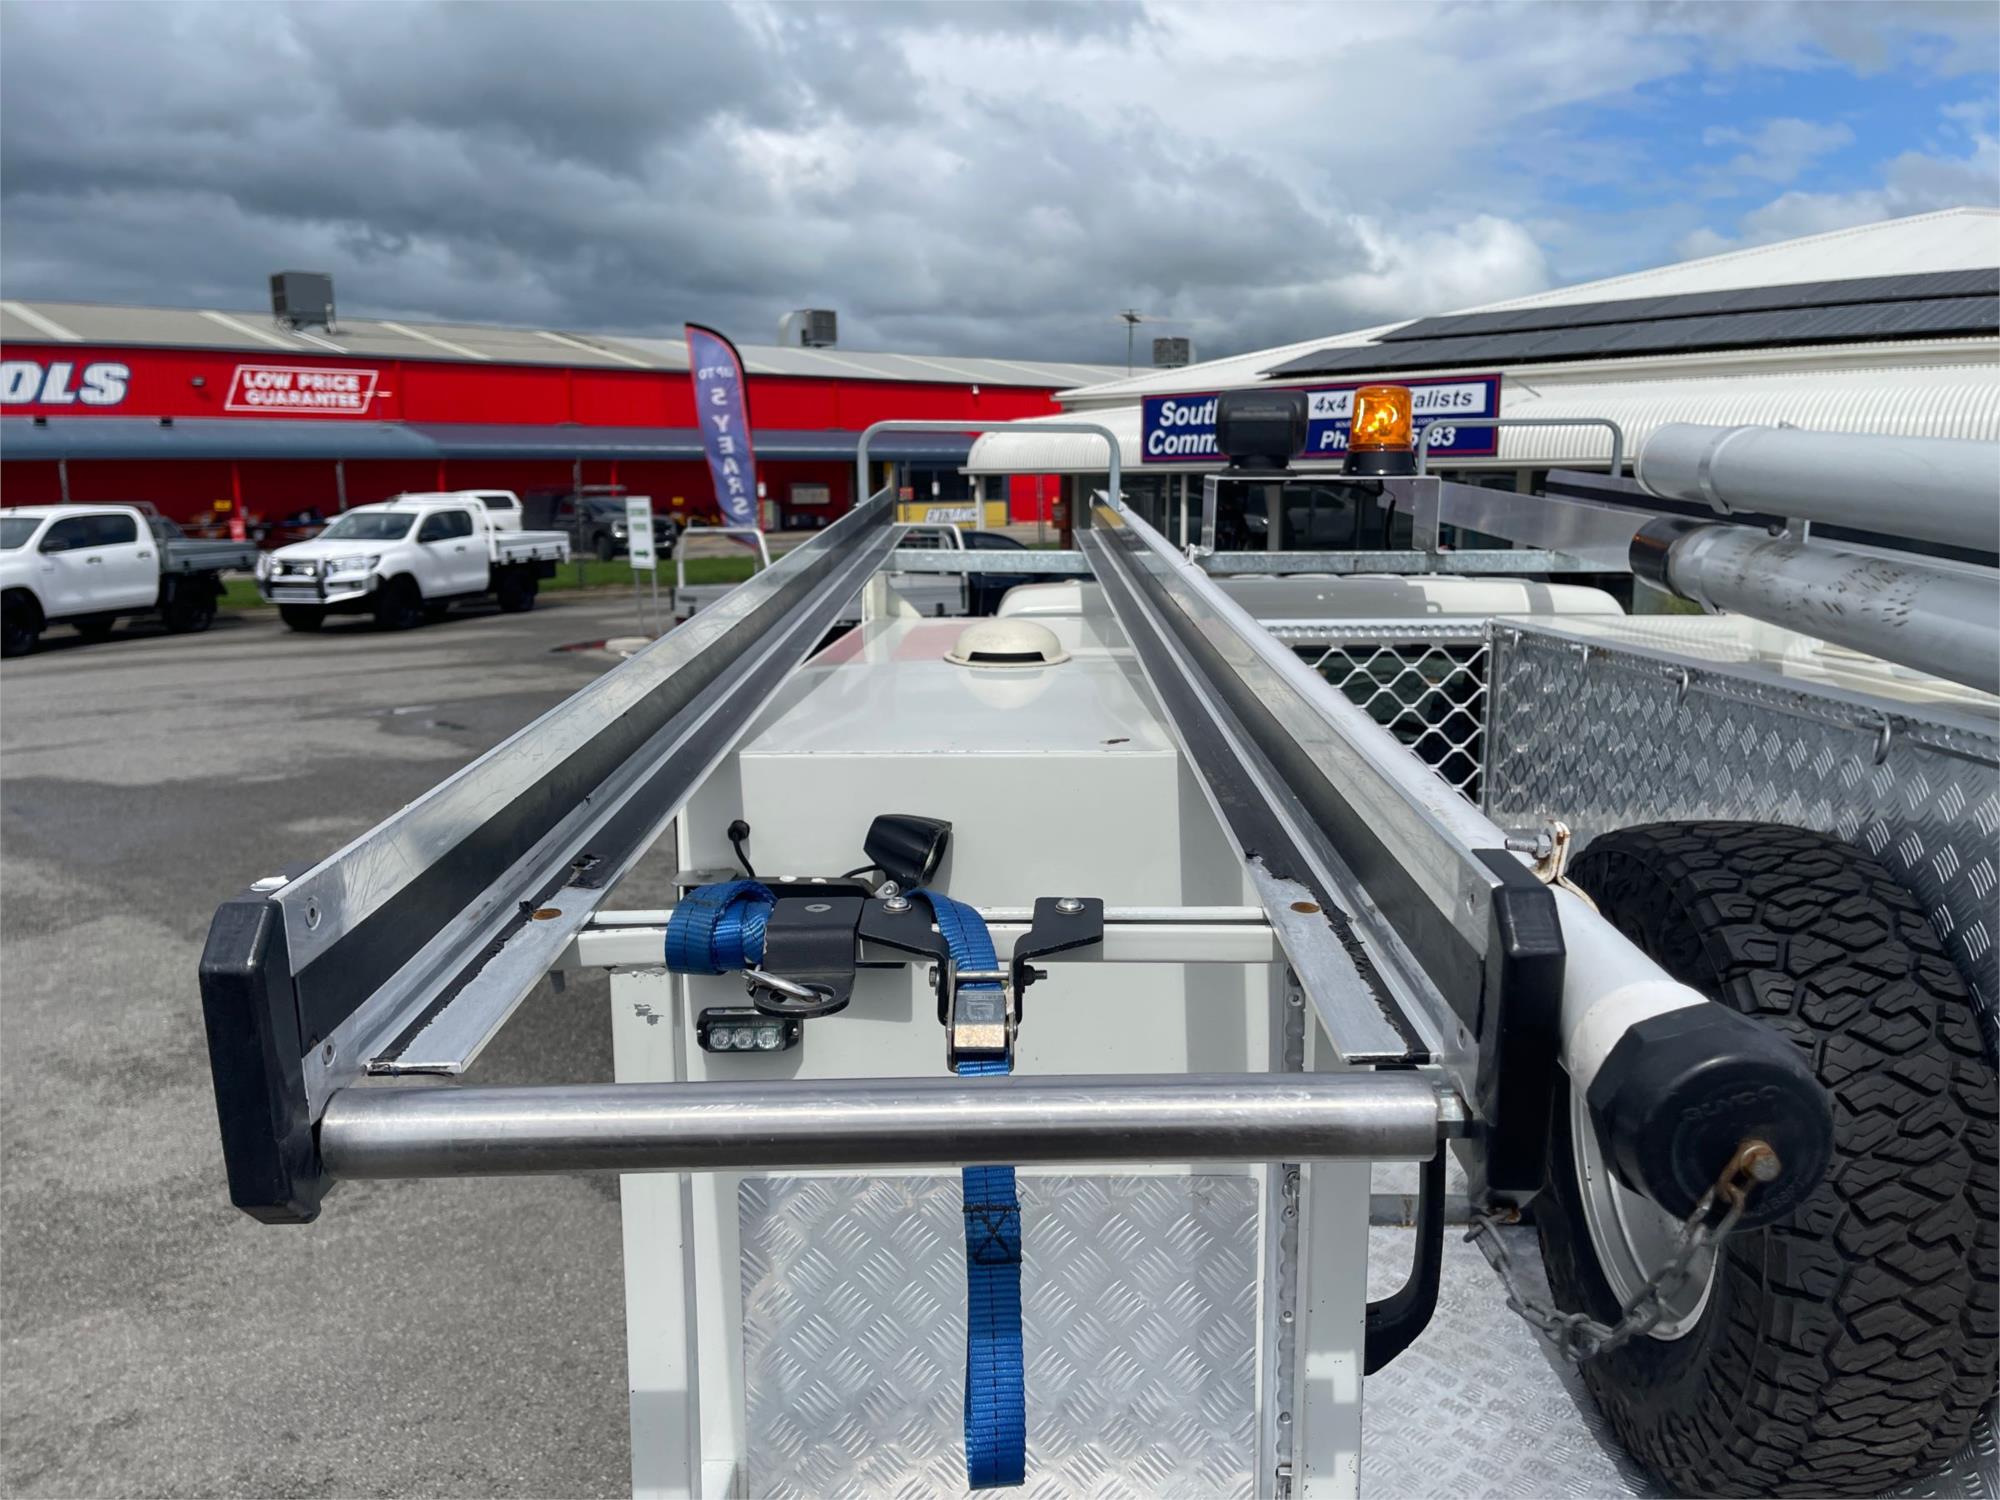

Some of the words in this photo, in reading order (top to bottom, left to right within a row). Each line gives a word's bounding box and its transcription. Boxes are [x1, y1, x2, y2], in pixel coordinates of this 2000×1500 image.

[243, 371, 293, 389] LOW
[297, 374, 361, 391] PRICE
[245, 389, 361, 407] GUARANTEE
[1314, 395, 1348, 412] 4x4
[1411, 389, 1474, 409] alists
